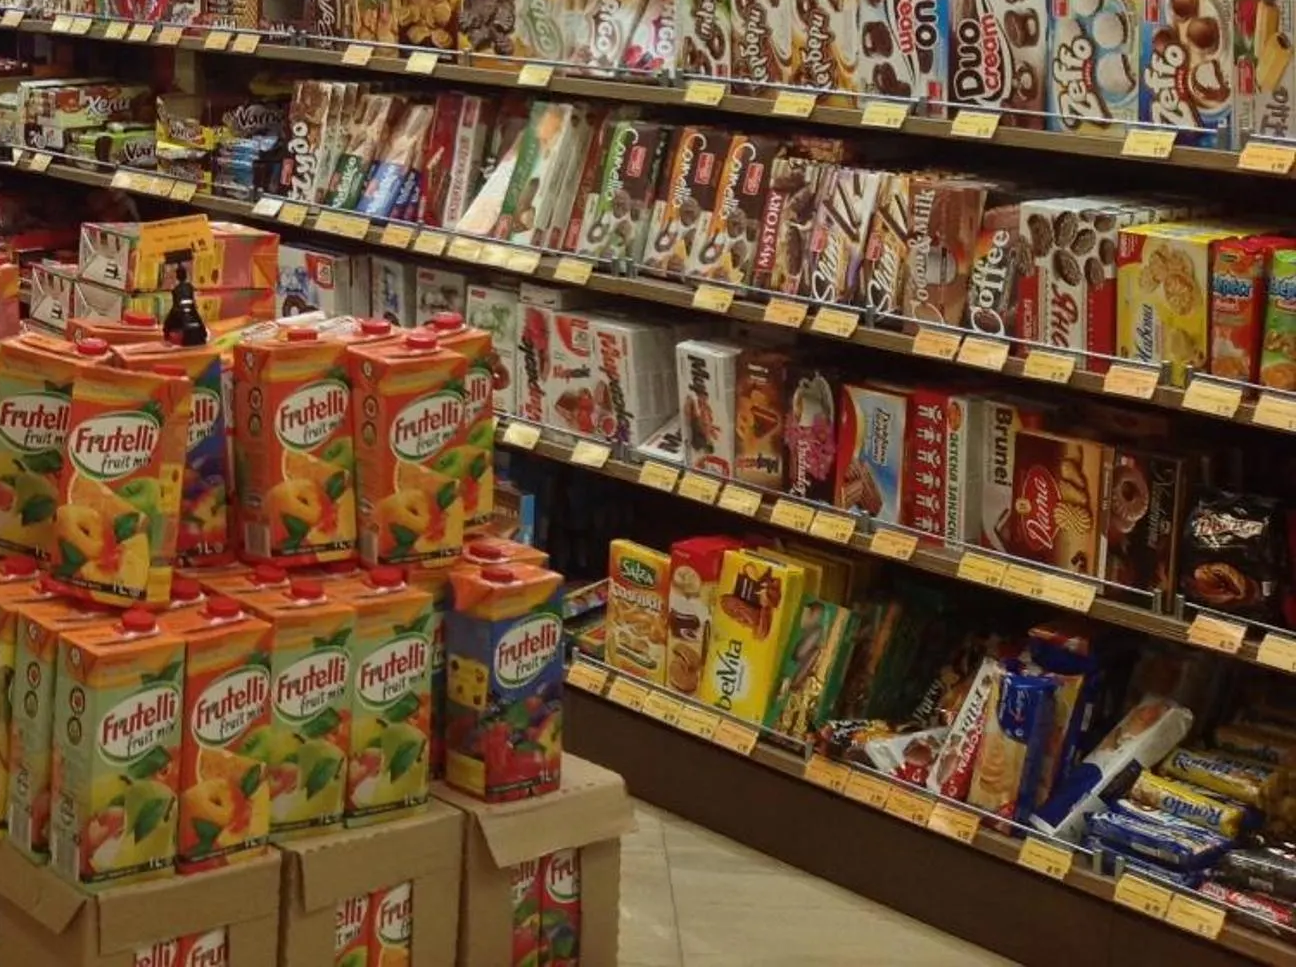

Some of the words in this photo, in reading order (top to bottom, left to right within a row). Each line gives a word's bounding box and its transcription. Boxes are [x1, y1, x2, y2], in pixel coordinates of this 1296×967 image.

[954, 18, 985, 101] Duo
[979, 13, 1002, 91] cream
[971, 231, 1010, 336] Coffee
[0, 401, 70, 430] Frutell
[279, 390, 346, 433] Frutelli
[394, 400, 461, 444] Frutelli
[75, 425, 155, 455] Frutelli
[101, 455, 132, 475] fruit
[1026, 478, 1056, 551] Dama
[359, 643, 427, 693] Frutelli
[497, 621, 559, 669] Frutelli
[275, 657, 348, 706] Frutelli
[713, 637, 744, 712] belVita
[101, 692, 177, 746] Frutelli
[195, 674, 267, 731] Frutelli
[219, 709, 245, 737] fruit
[300, 693, 326, 717] fruit
[127, 730, 153, 759] fruit
